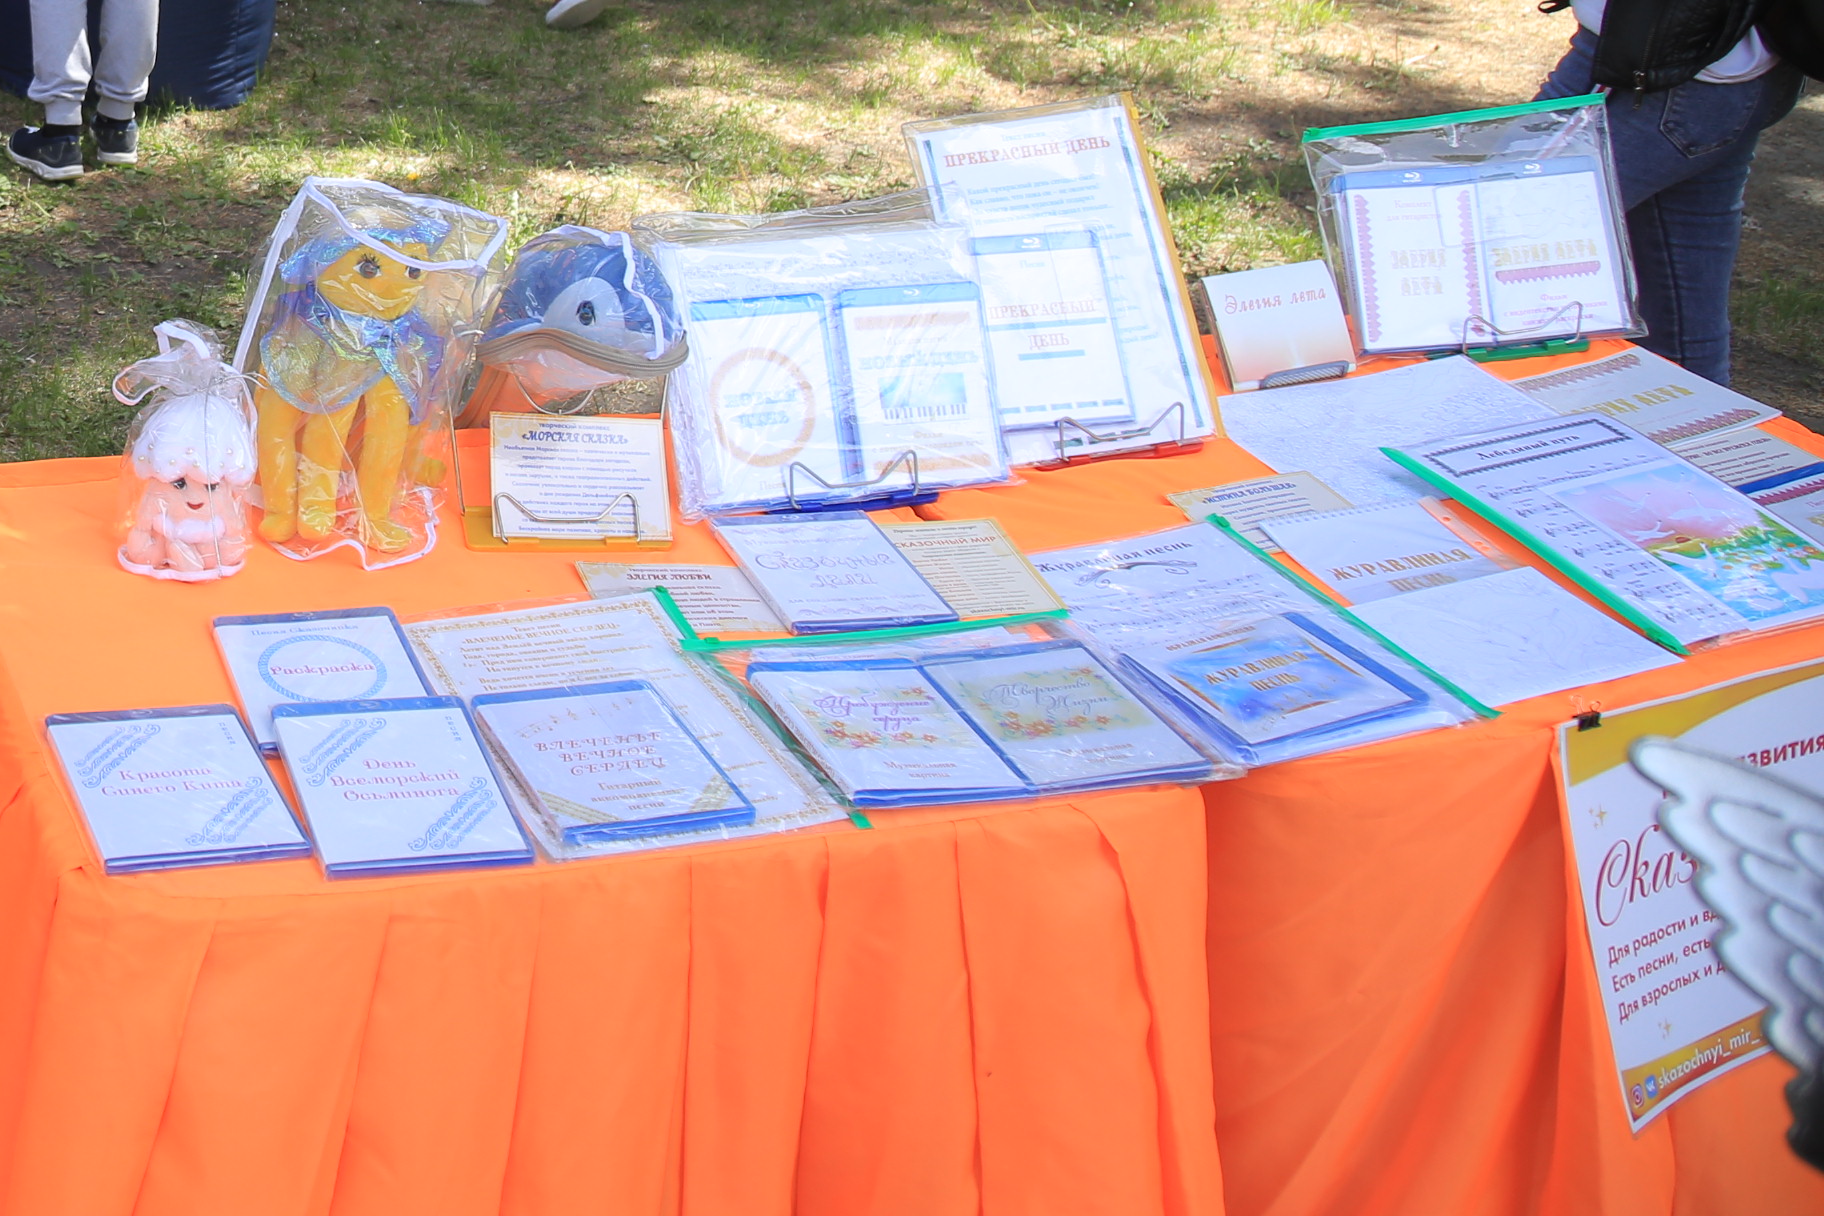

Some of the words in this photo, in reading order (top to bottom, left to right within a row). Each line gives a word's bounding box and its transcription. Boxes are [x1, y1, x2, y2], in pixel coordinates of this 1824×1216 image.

[943, 142, 1061, 168] ПРЕКРАСНЫЙ
[1065, 136, 1111, 155] ДЕНЬ
[1223, 293, 1283, 316] Элегия
[1291, 286, 1327, 306] лета
[1028, 332, 1070, 350] ДЕНЬ
[521, 430, 581, 444] «МОРСКАЯ
[581, 432, 629, 445] СКАЗКА»
[1476, 440, 1549, 462] Лебединый
[1550, 435, 1581, 450] путь
[894, 537, 969, 550] СКАЗОЧНЫЙ
[970, 536, 997, 545] МИР
[1144, 540, 1195, 558] песнь
[1326, 547, 1474, 582] ЖУРАВЛИНАЯ
[626, 573, 669, 581] ЭЛЕГИЯ
[670, 573, 713, 581] ЛЮБВИ
[1387, 571, 1459, 593] ПЕСНЬ
[526, 628, 572, 639] ВЕЧНОЕ
[269, 661, 376, 677] Раскраска
[1202, 650, 1310, 686] ЖУРАВЛИНАЯ
[1248, 671, 1303, 692] ПЕСНЬ
[982, 676, 1091, 711] Творчество
[813, 691, 931, 718] Пробуждение
[1041, 695, 1109, 716] Жизни
[872, 715, 922, 732] сердца
[533, 730, 663, 753] ВЛЕЧЕНЬЕ
[362, 758, 417, 771] День
[558, 744, 657, 764] ВЕЧНОЕ
[118, 766, 213, 783] Красота
[570, 757, 667, 777] СЕРДЕЦ
[100, 785, 178, 798] Синего
[182, 778, 243, 792] Кита
[329, 769, 461, 788] Всеморский
[342, 785, 461, 803] Осьминога
[1595, 824, 1699, 927] Сказ
[1607, 944, 1631, 969] Для
[1632, 919, 1687, 958] радости
[1689, 914, 1699, 928] и
[1611, 971, 1636, 994] Есть
[1638, 950, 1679, 980] песни,
[1682, 936, 1713, 958] есть
[1618, 999, 1640, 1025] Для
[1641, 968, 1702, 1007] взрослых
[1703, 963, 1714, 978] и
[1657, 1028, 1764, 1090] skazochnyi_mir_
